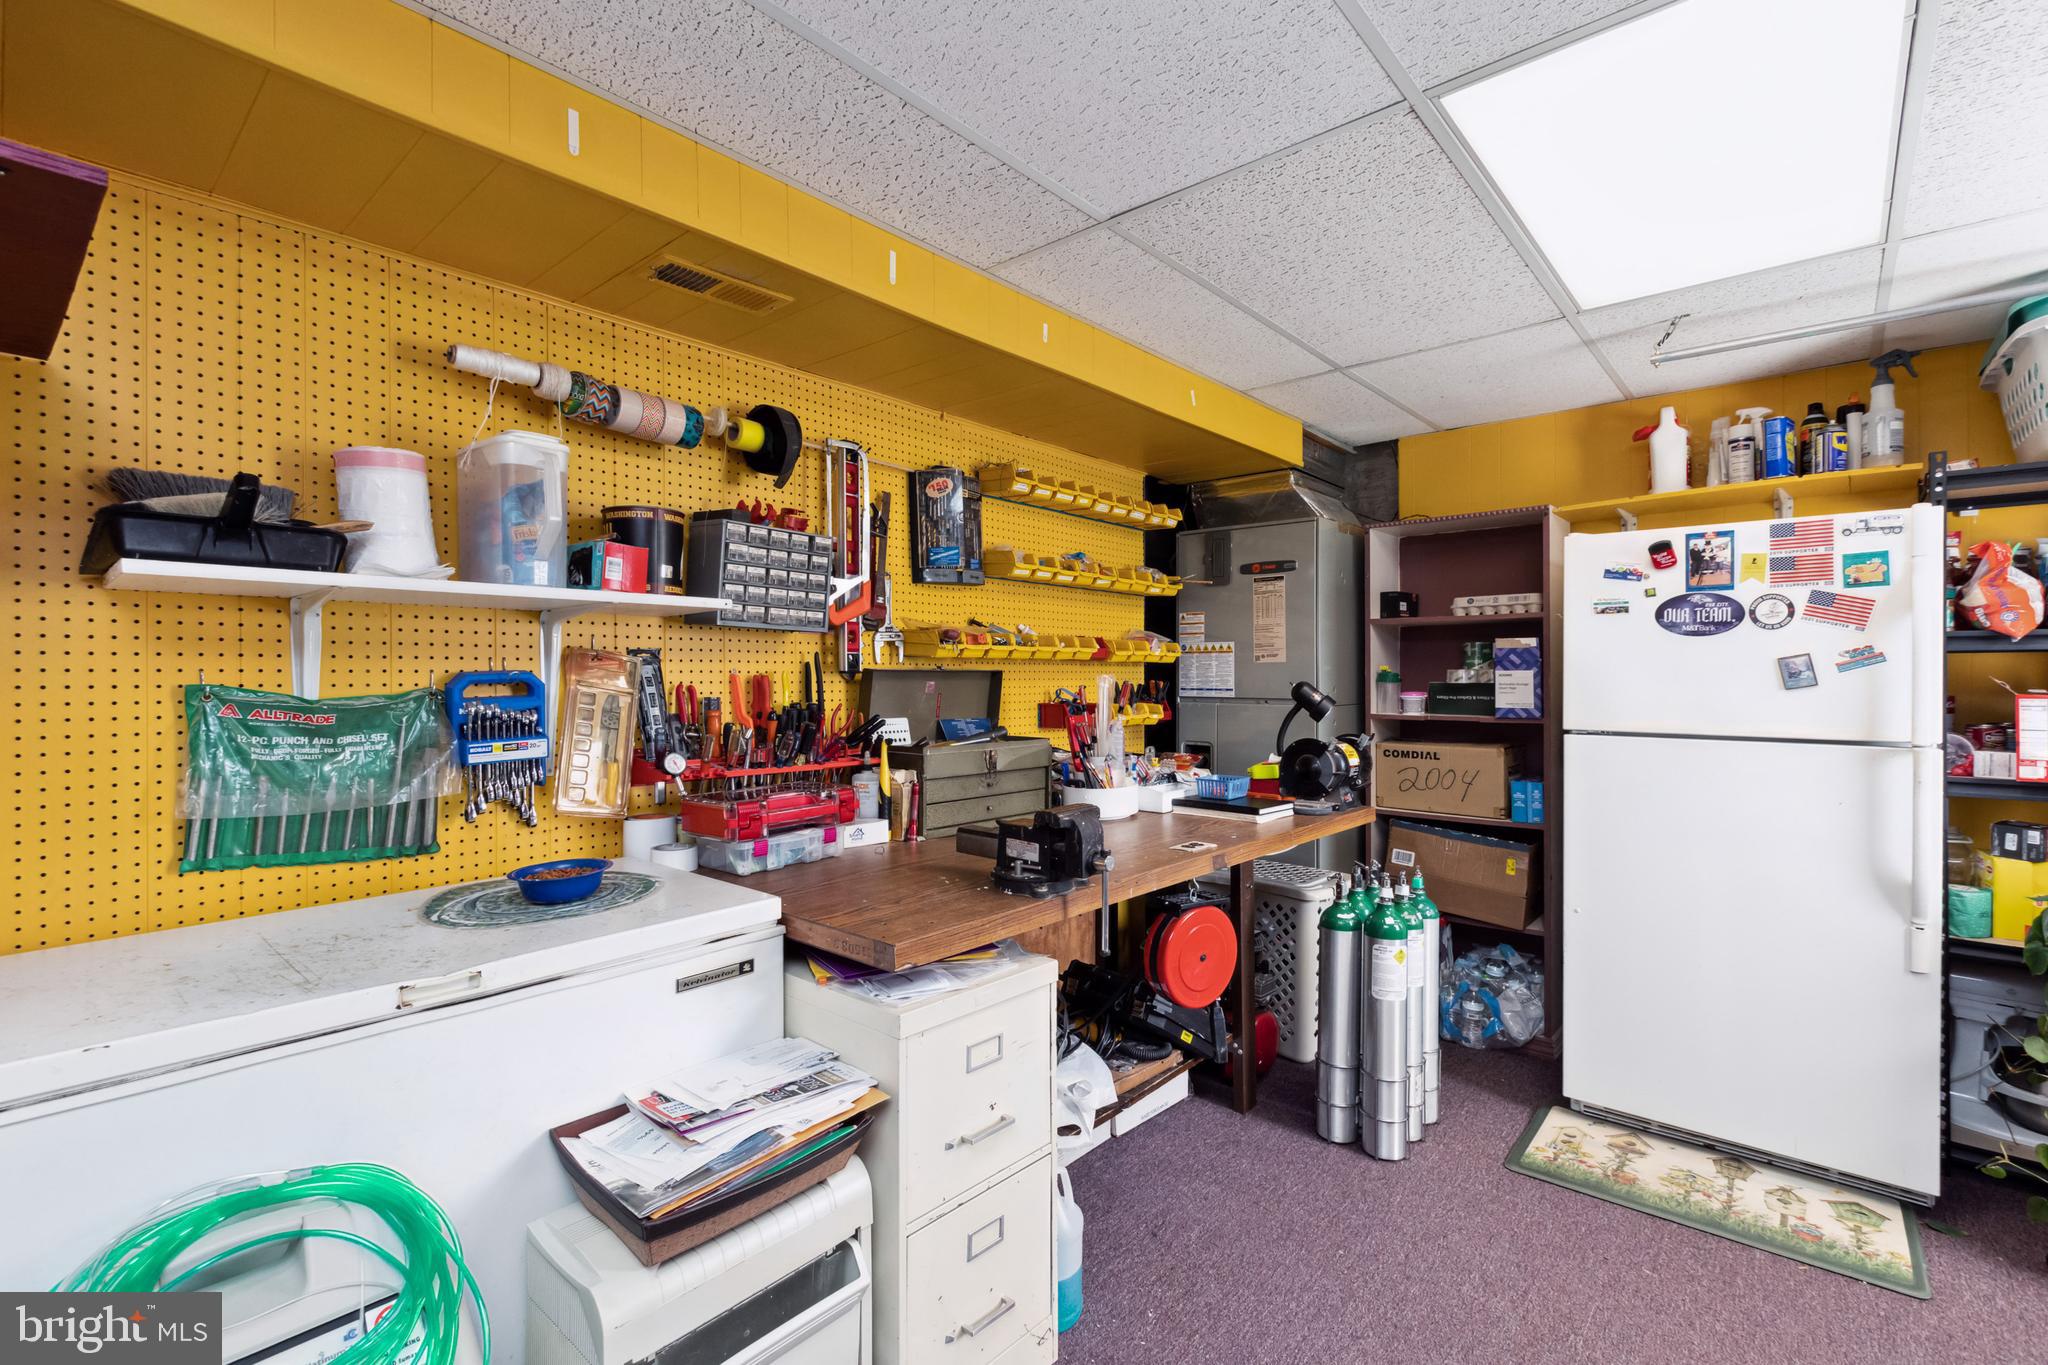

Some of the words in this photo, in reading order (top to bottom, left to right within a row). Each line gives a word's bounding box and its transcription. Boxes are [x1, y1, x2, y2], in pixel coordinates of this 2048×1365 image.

[605, 510, 654, 519] WASHINGTON
[1762, 593, 1791, 605] SUPPORTER
[1663, 607, 1690, 623] OUR
[1693, 606, 1736, 622] TEAM.
[1815, 619, 1850, 629] SUPPORTER
[248, 708, 337, 726] ALLTRADE
[271, 736, 309, 746] PUNCH
[337, 733, 366, 744] CHISEL
[369, 732, 389, 743] SET
[469, 745, 493, 753] KOBALT
[1383, 749, 1441, 761] COMDIAL
[1396, 766, 1480, 803] 2004
[681, 967, 737, 989] Kelvinator
